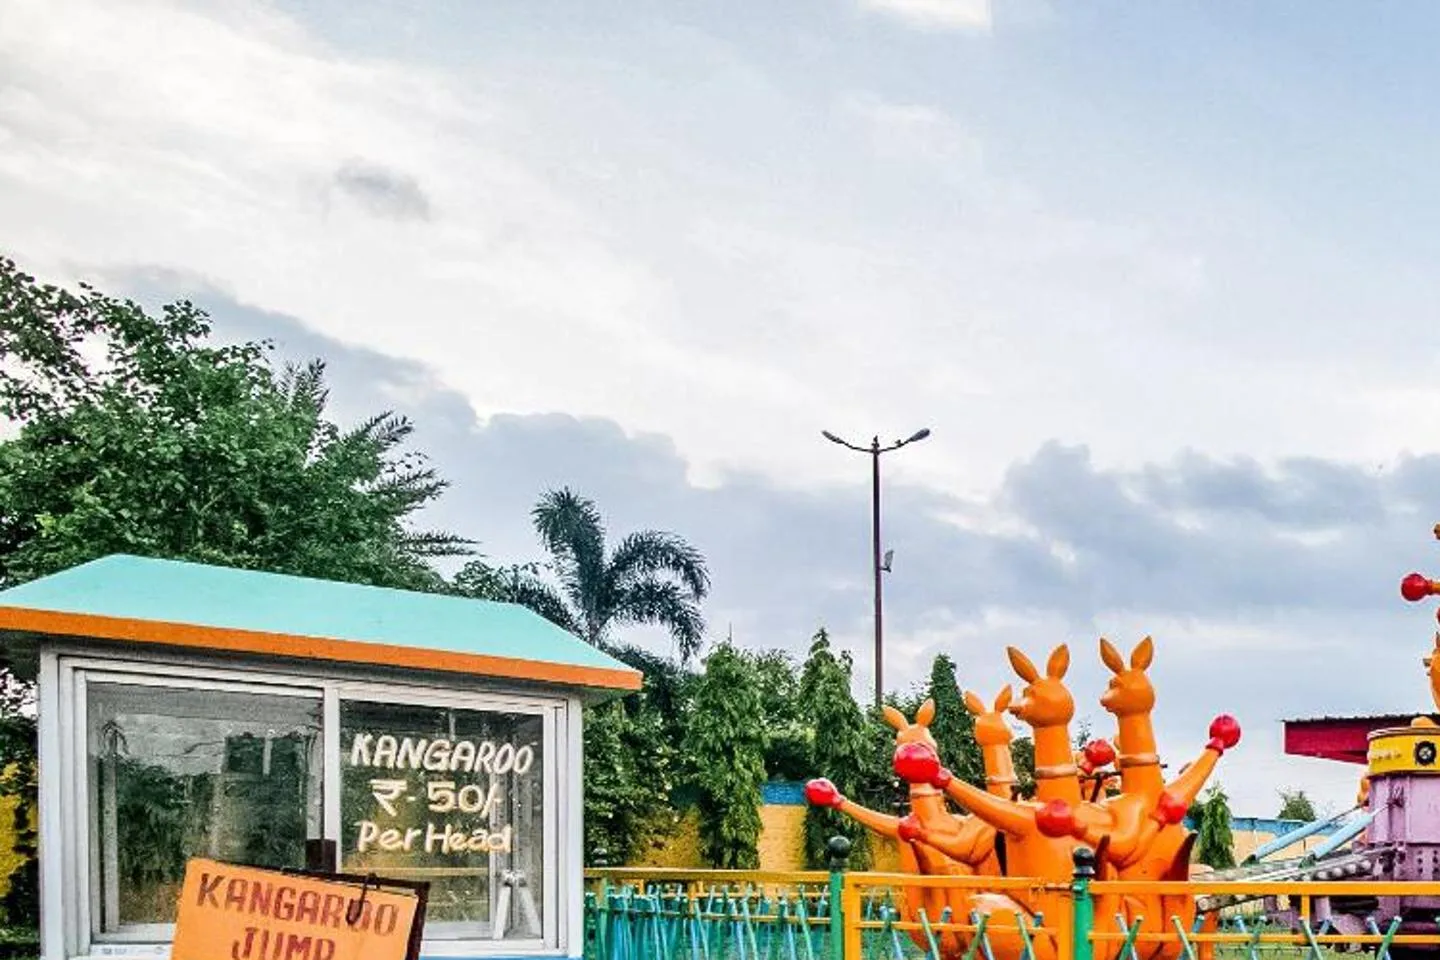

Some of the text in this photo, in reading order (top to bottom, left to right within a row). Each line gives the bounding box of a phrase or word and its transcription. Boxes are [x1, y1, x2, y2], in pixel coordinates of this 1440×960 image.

[350, 733, 534, 775] KANGAROO
[354, 820, 512, 854] Per Head
[196, 872, 398, 937] KANGAROO
